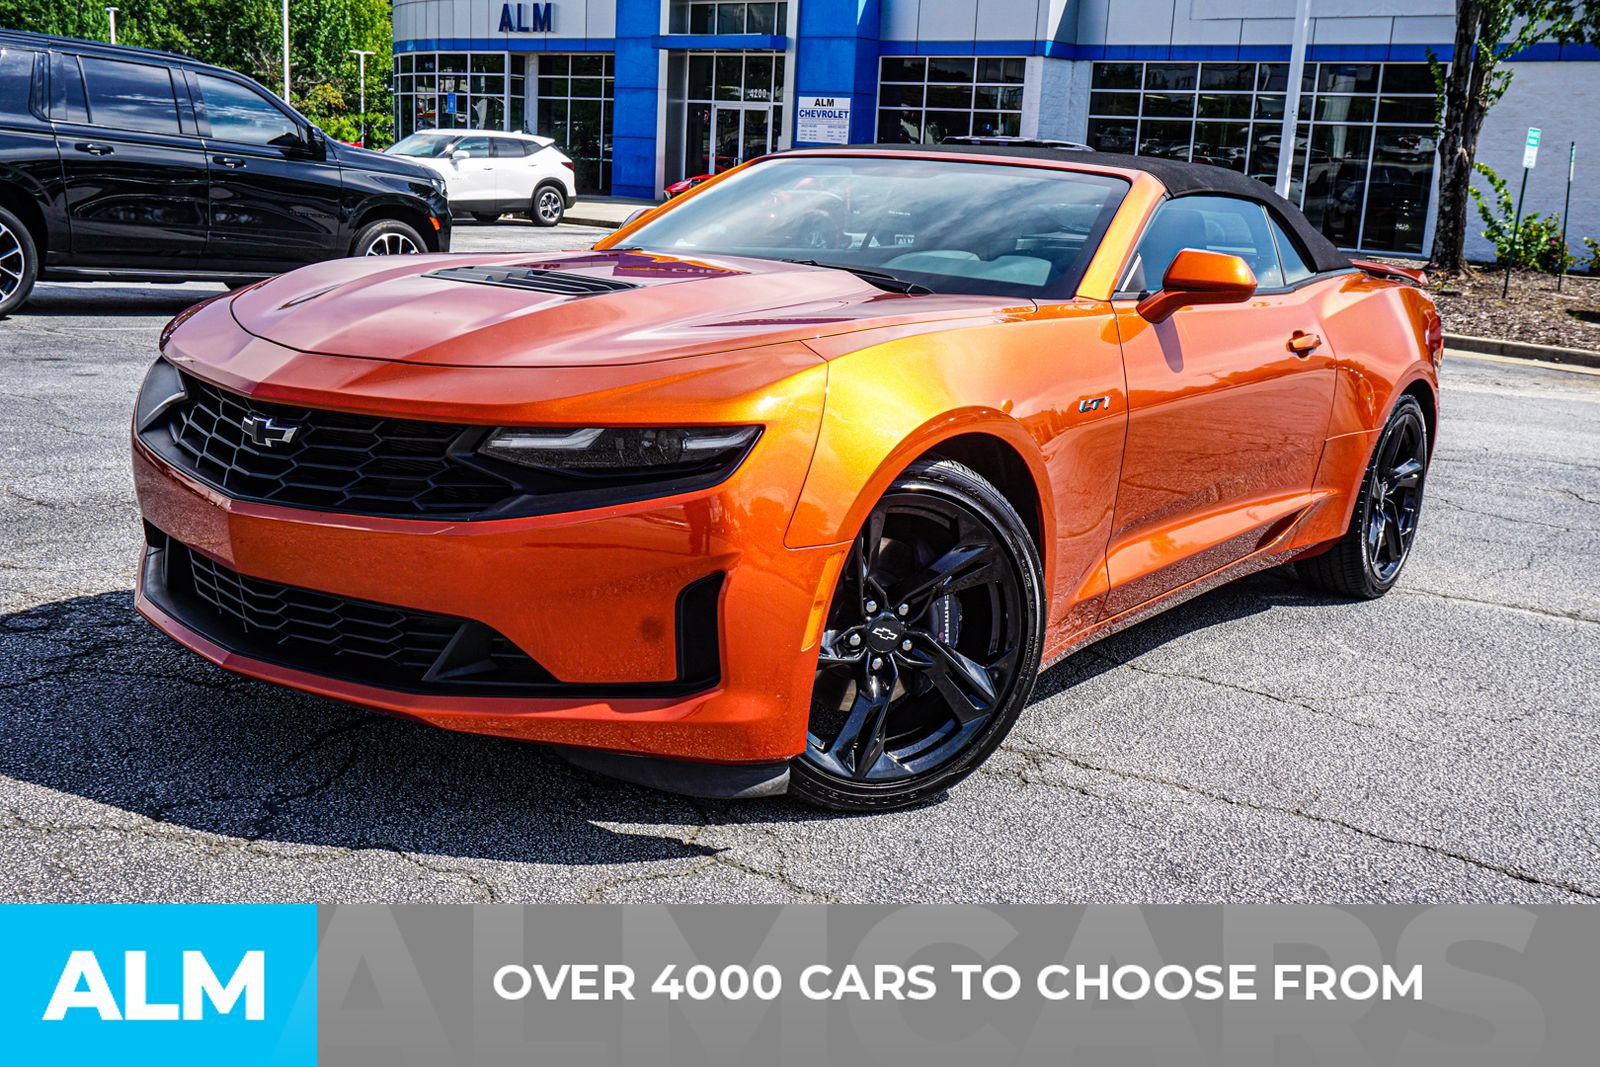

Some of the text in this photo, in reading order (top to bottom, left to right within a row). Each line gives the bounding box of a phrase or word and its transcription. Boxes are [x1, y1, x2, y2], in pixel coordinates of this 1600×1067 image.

[498, 3, 552, 32] ALM
[750, 88, 767, 98] 4200
[814, 98, 835, 107] ALM
[799, 109, 849, 119] CHEVROLET
[1078, 395, 1111, 413] LT1
